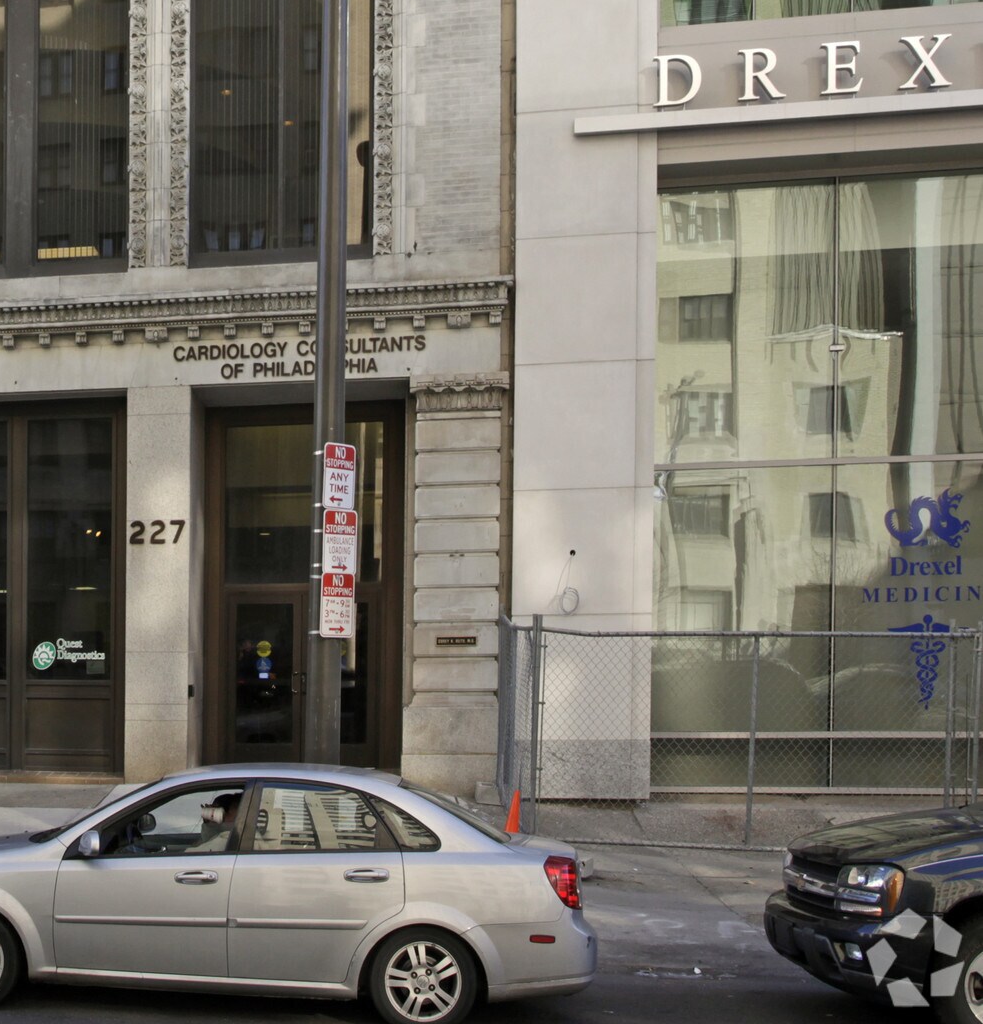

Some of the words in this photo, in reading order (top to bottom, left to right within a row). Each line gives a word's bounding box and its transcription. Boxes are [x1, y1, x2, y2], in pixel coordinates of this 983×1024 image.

[653, 33, 952, 108] DREX
[173, 341, 288, 363] CARDIOLOGY
[296, 335, 427, 357] CULTANTS
[221, 363, 244, 380] OF
[253, 358, 378, 378] PHILADHIA
[335, 446, 347, 460] NO
[326, 458, 354, 470] STOPPING
[330, 472, 349, 482] ANY
[330, 483, 349, 494] TIME
[334, 511, 347, 525] NO
[129, 519, 186, 545] 227
[325, 524, 355, 535] STOPPING
[326, 536, 354, 546] AMBULANCE
[328, 546, 351, 555] LOADING
[331, 555, 348, 563] ONLY
[890, 555, 962, 577] Drexel
[332, 574, 345, 587] NO
[323, 586, 353, 597] STOPPING
[862, 585, 981, 603] MEDICIN
[56, 638, 83, 651] Quest
[56, 649, 106, 663] Diagnostics
